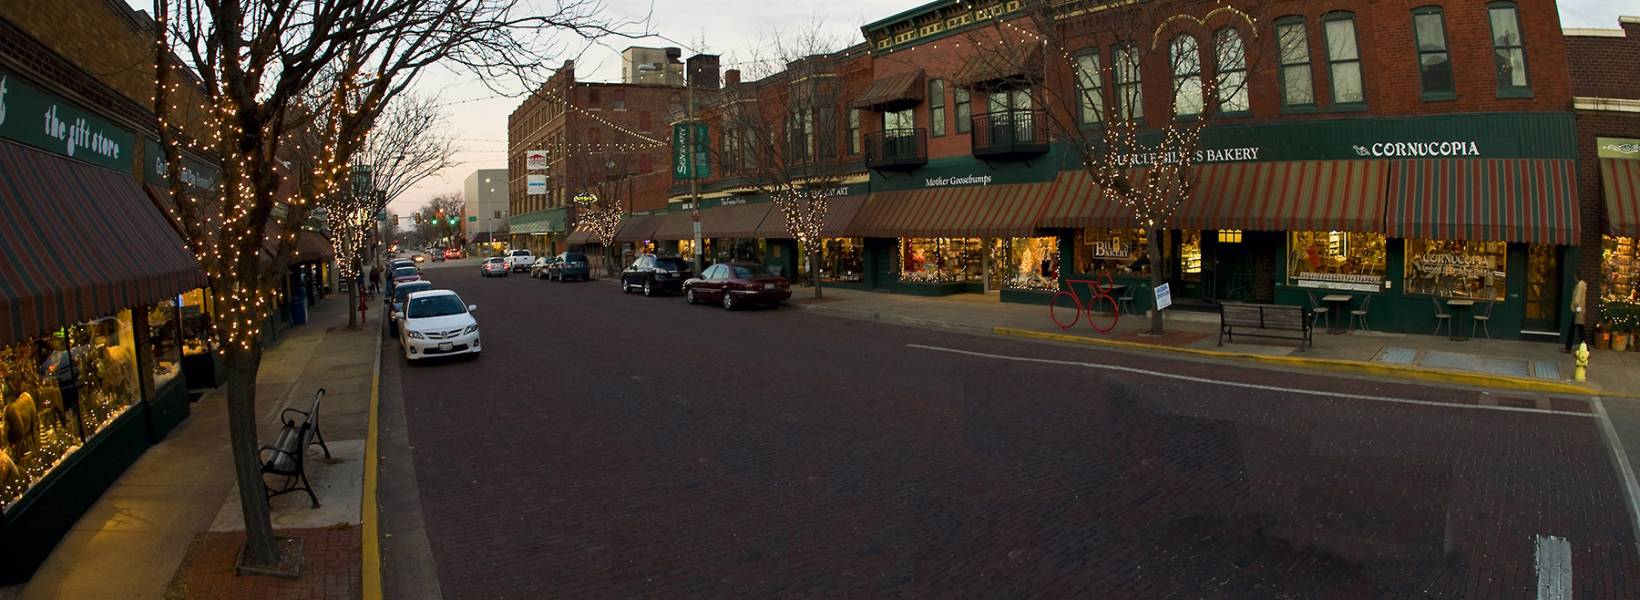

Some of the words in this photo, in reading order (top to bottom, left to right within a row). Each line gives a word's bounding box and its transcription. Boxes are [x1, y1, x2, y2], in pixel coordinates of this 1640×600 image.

[45, 105, 66, 141] the
[67, 118, 90, 157] gift
[92, 129, 120, 160] store
[1207, 147, 1259, 161] BAKERY
[1372, 141, 1480, 156] CORNUCOPIA
[925, 177, 949, 187] Mother
[950, 174, 992, 186] Goosebumps
[1423, 254, 1489, 265] CORNUCOPIA
